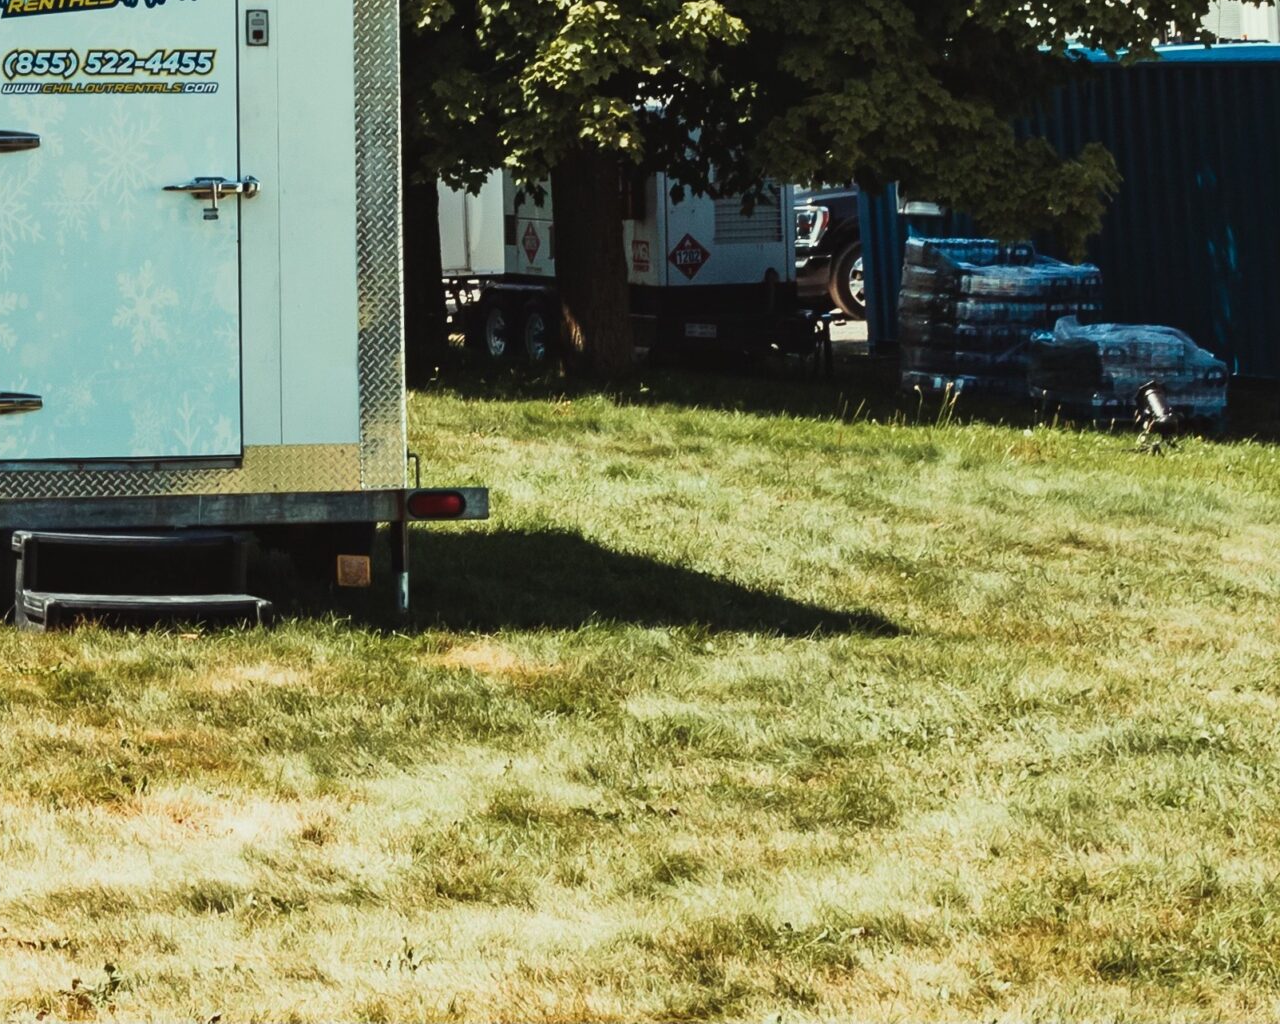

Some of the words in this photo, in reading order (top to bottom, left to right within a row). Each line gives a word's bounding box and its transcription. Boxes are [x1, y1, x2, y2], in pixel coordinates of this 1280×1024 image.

[2, 49, 80, 80] (855)
[83, 49, 217, 77] 522-4455
[677, 250, 700, 263] 1202
